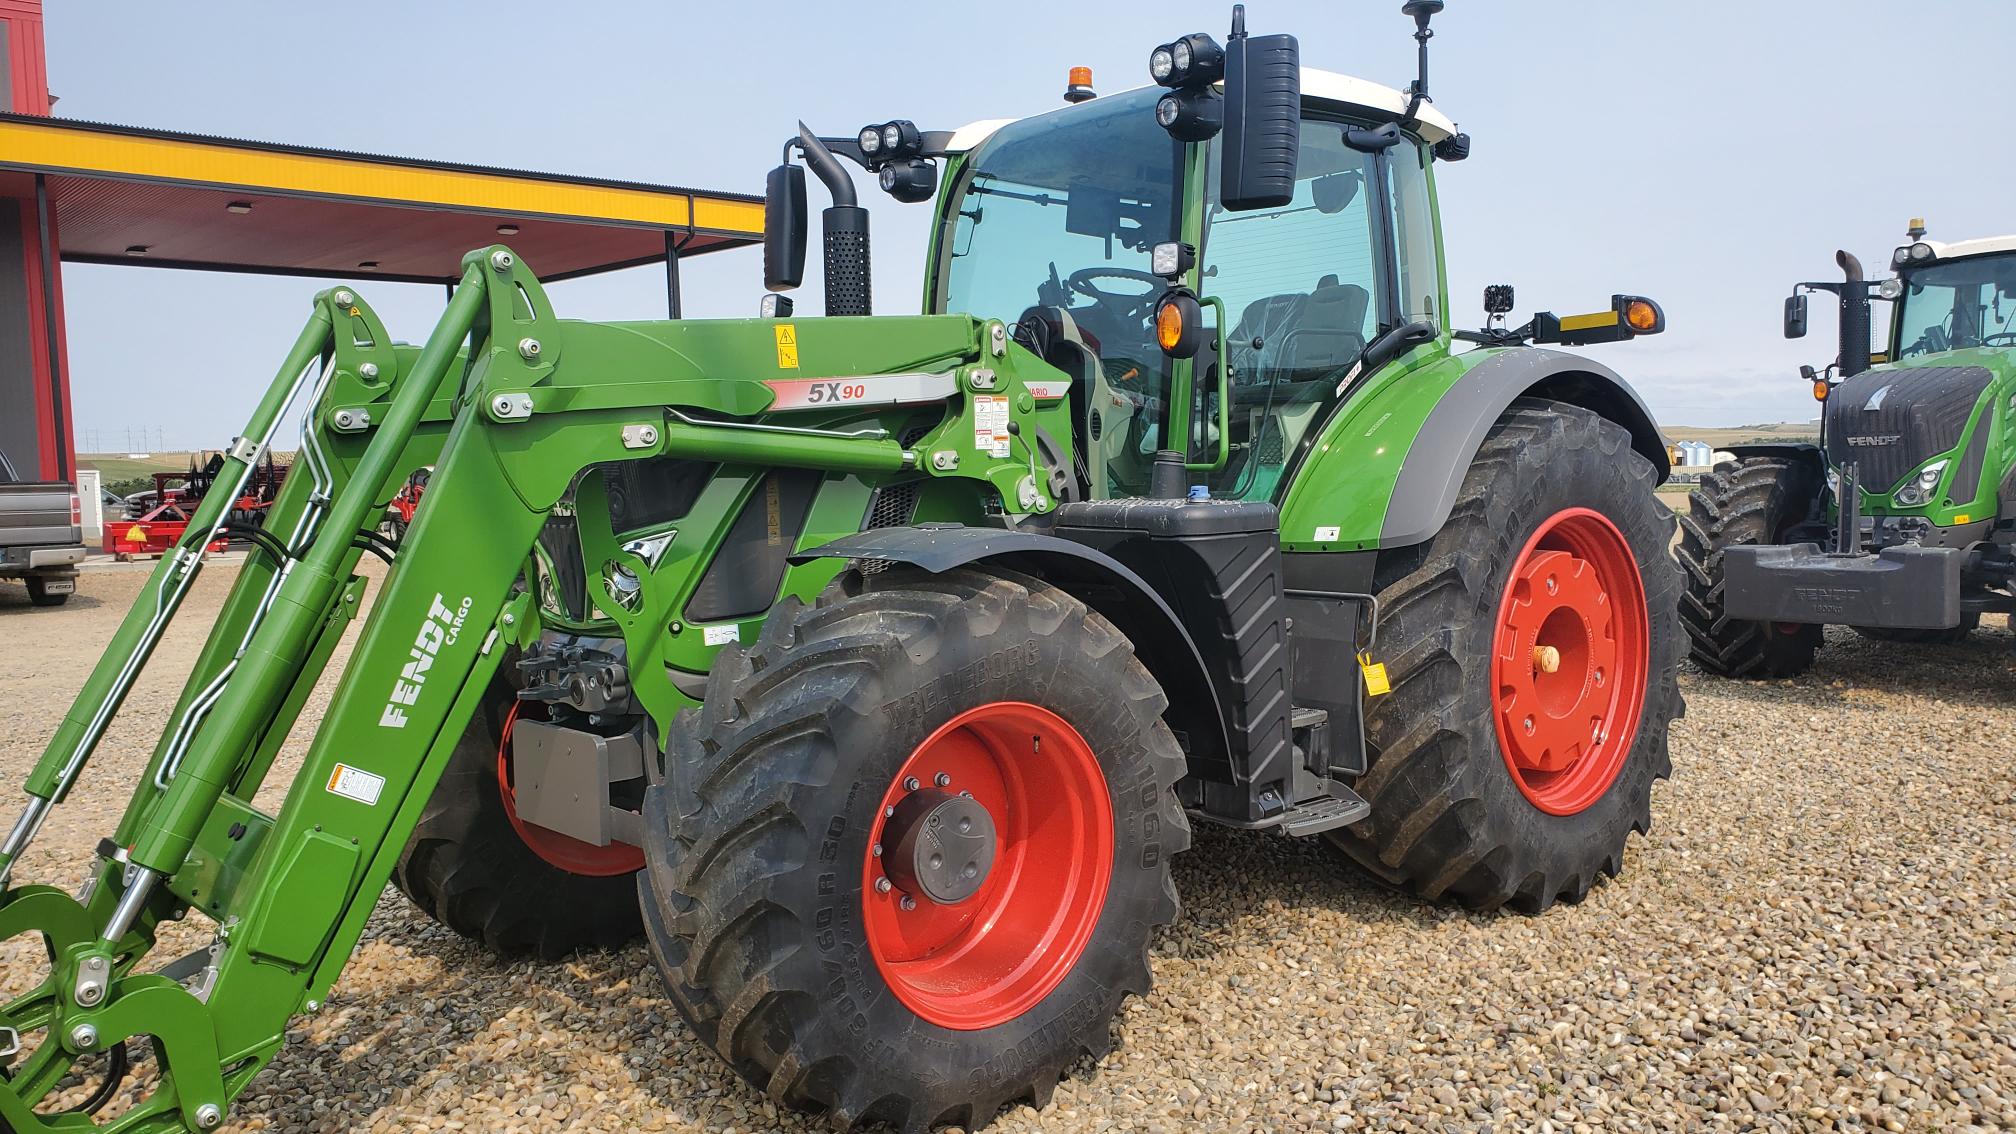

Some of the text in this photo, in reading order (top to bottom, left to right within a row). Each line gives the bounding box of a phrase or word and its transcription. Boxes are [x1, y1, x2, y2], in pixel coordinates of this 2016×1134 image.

[1846, 435, 1901, 447] FENDT
[378, 592, 454, 729] FENDT
[445, 596, 473, 646] CARGO
[880, 638, 1041, 730] TRELLEBORG
[1112, 700, 1161, 870] TM1060
